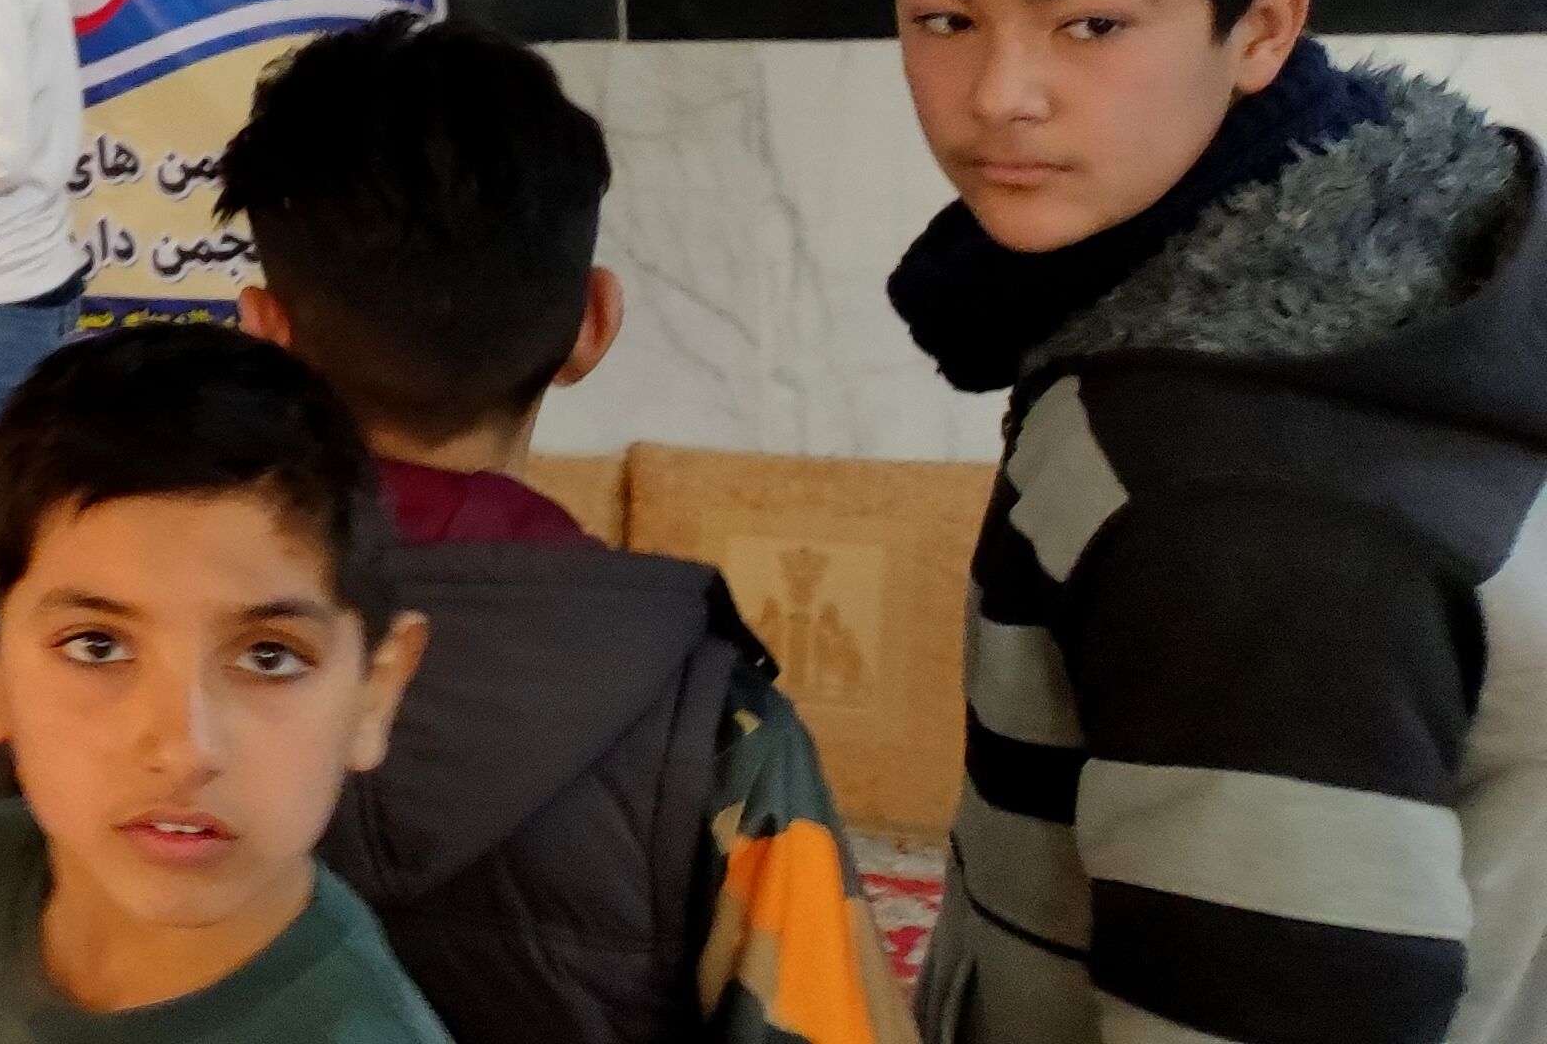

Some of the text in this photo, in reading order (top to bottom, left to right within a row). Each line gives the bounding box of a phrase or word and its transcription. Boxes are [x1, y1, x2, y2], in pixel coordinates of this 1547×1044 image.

[66, 132, 140, 193] های
[69, 217, 261, 278] جمن دار
